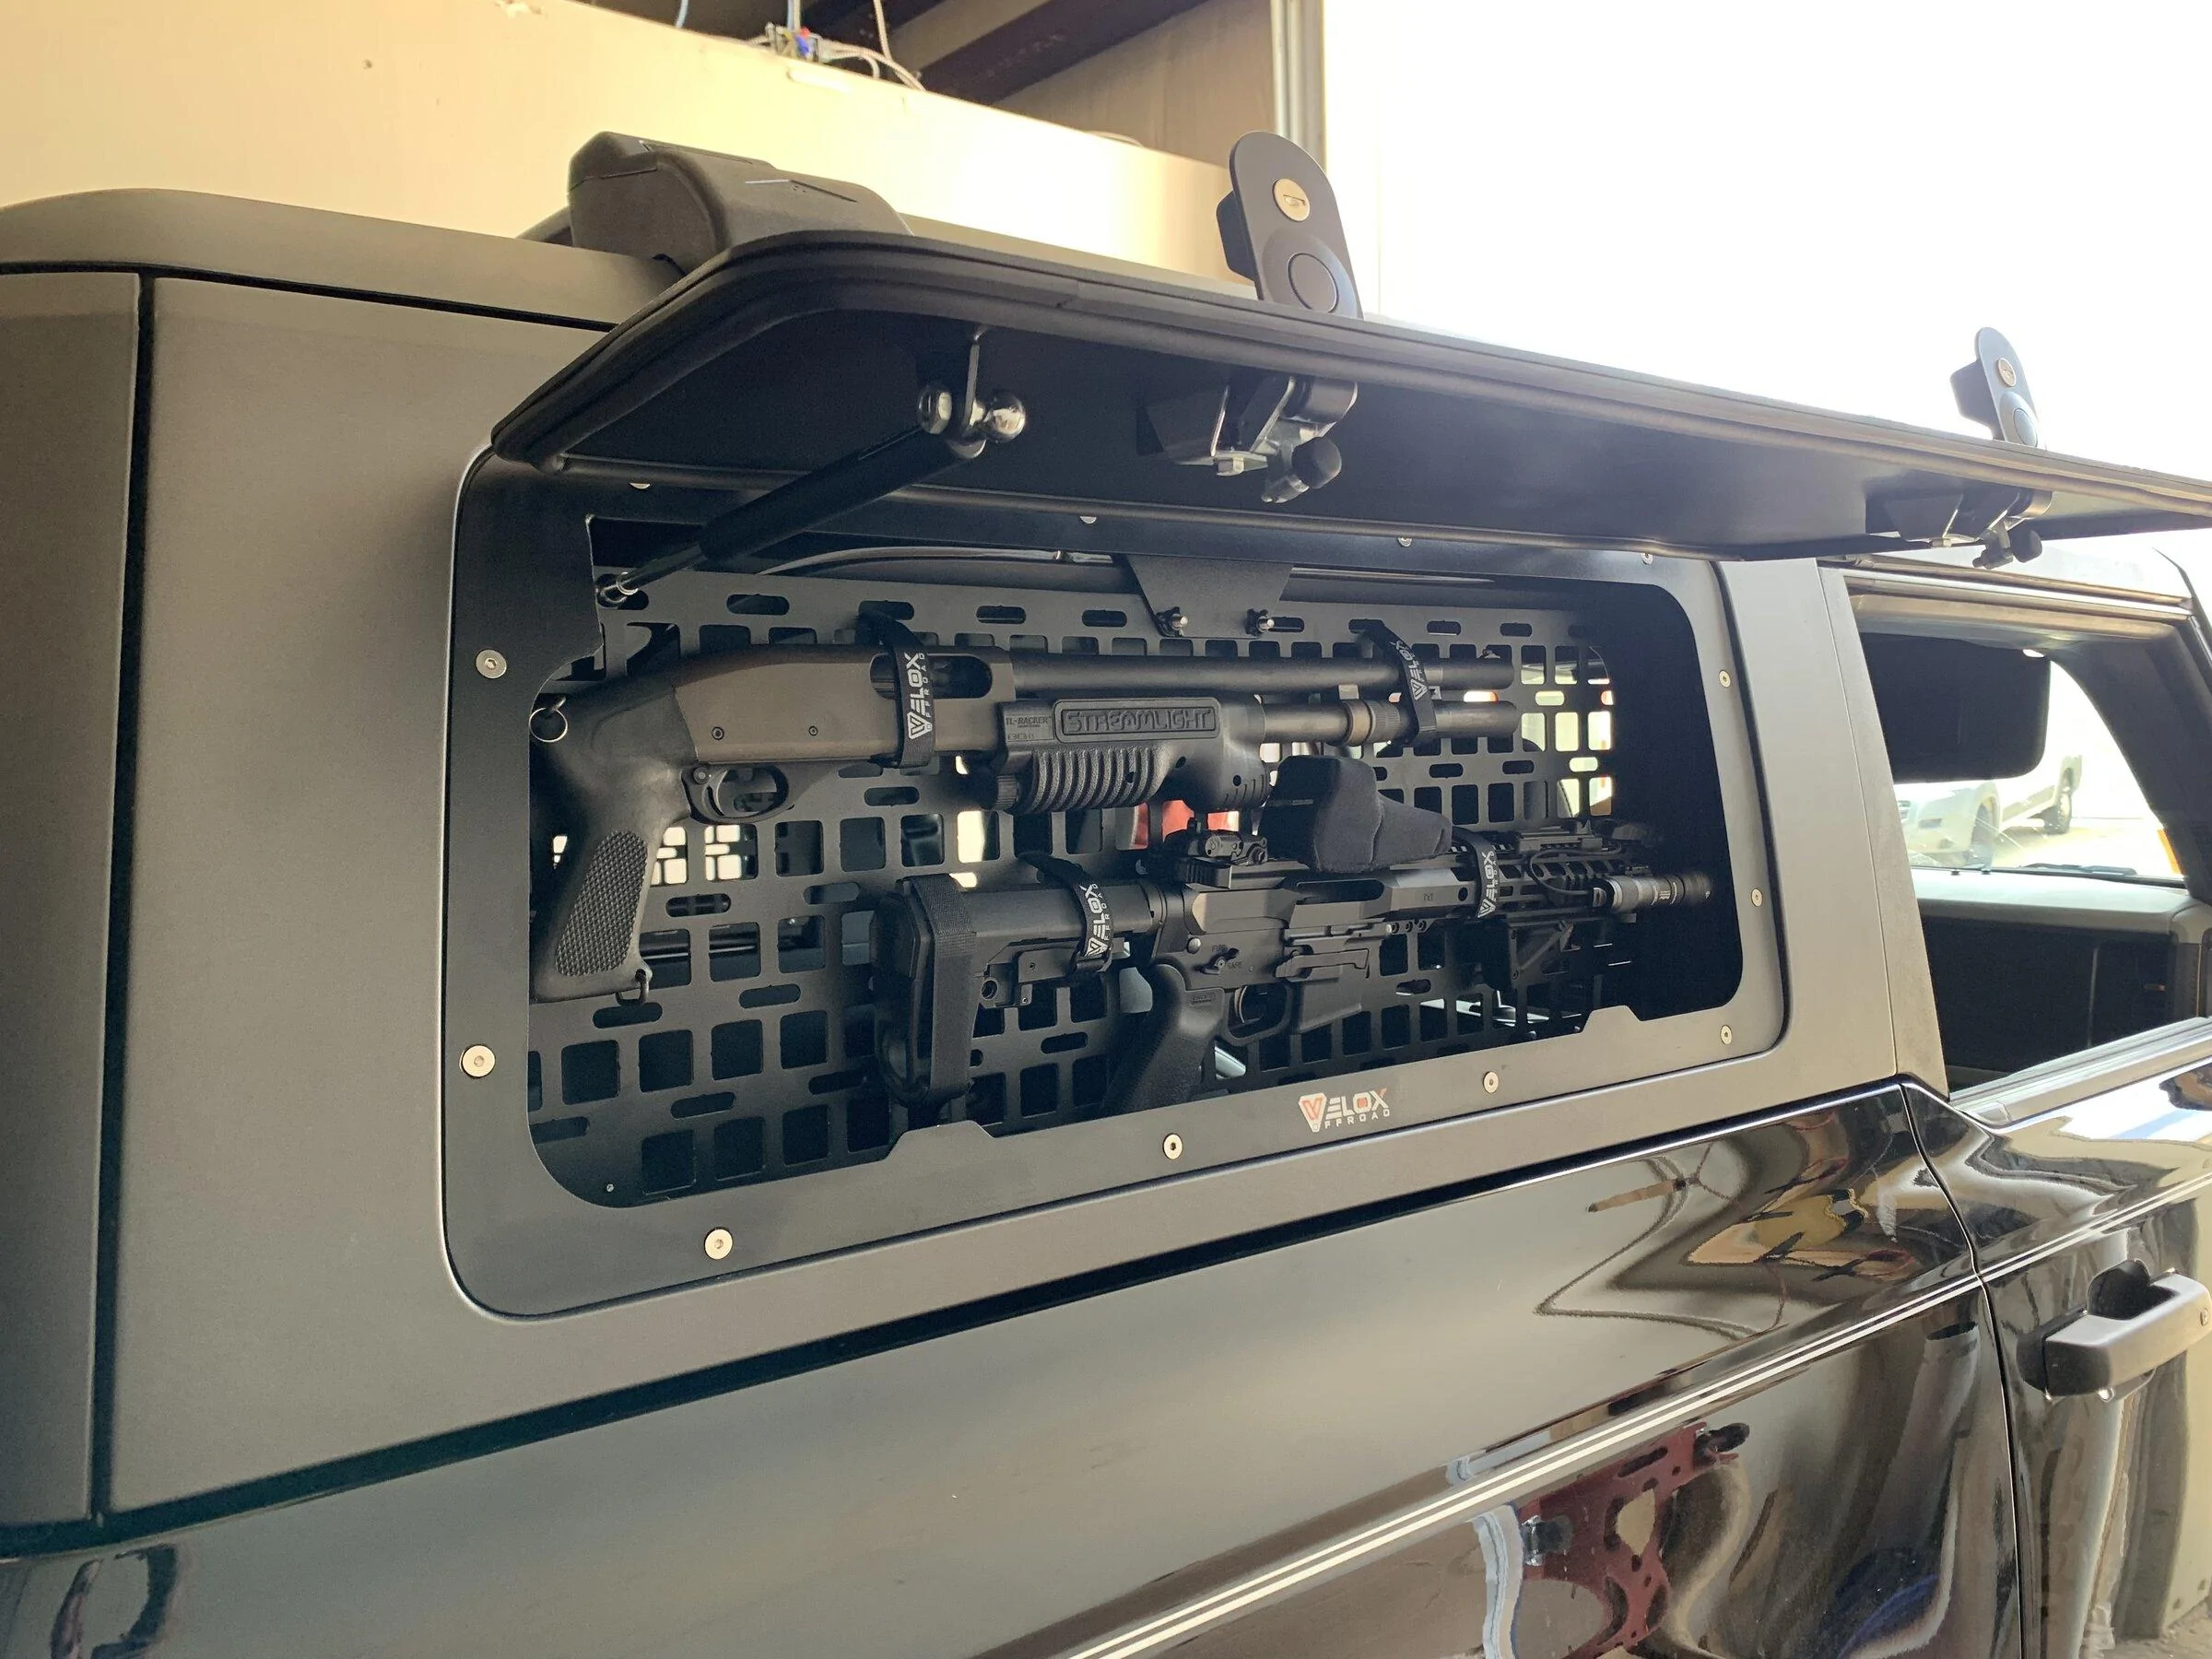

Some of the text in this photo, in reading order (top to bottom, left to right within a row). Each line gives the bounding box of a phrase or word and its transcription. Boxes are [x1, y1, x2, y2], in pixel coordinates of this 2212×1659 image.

[904, 653, 932, 739] VELOX
[1066, 709, 1215, 733] STREAMLIGHT
[1477, 851, 1496, 918] VELOX
[1079, 885, 1108, 957] VELOX
[1299, 1088, 1389, 1133] VELOX
